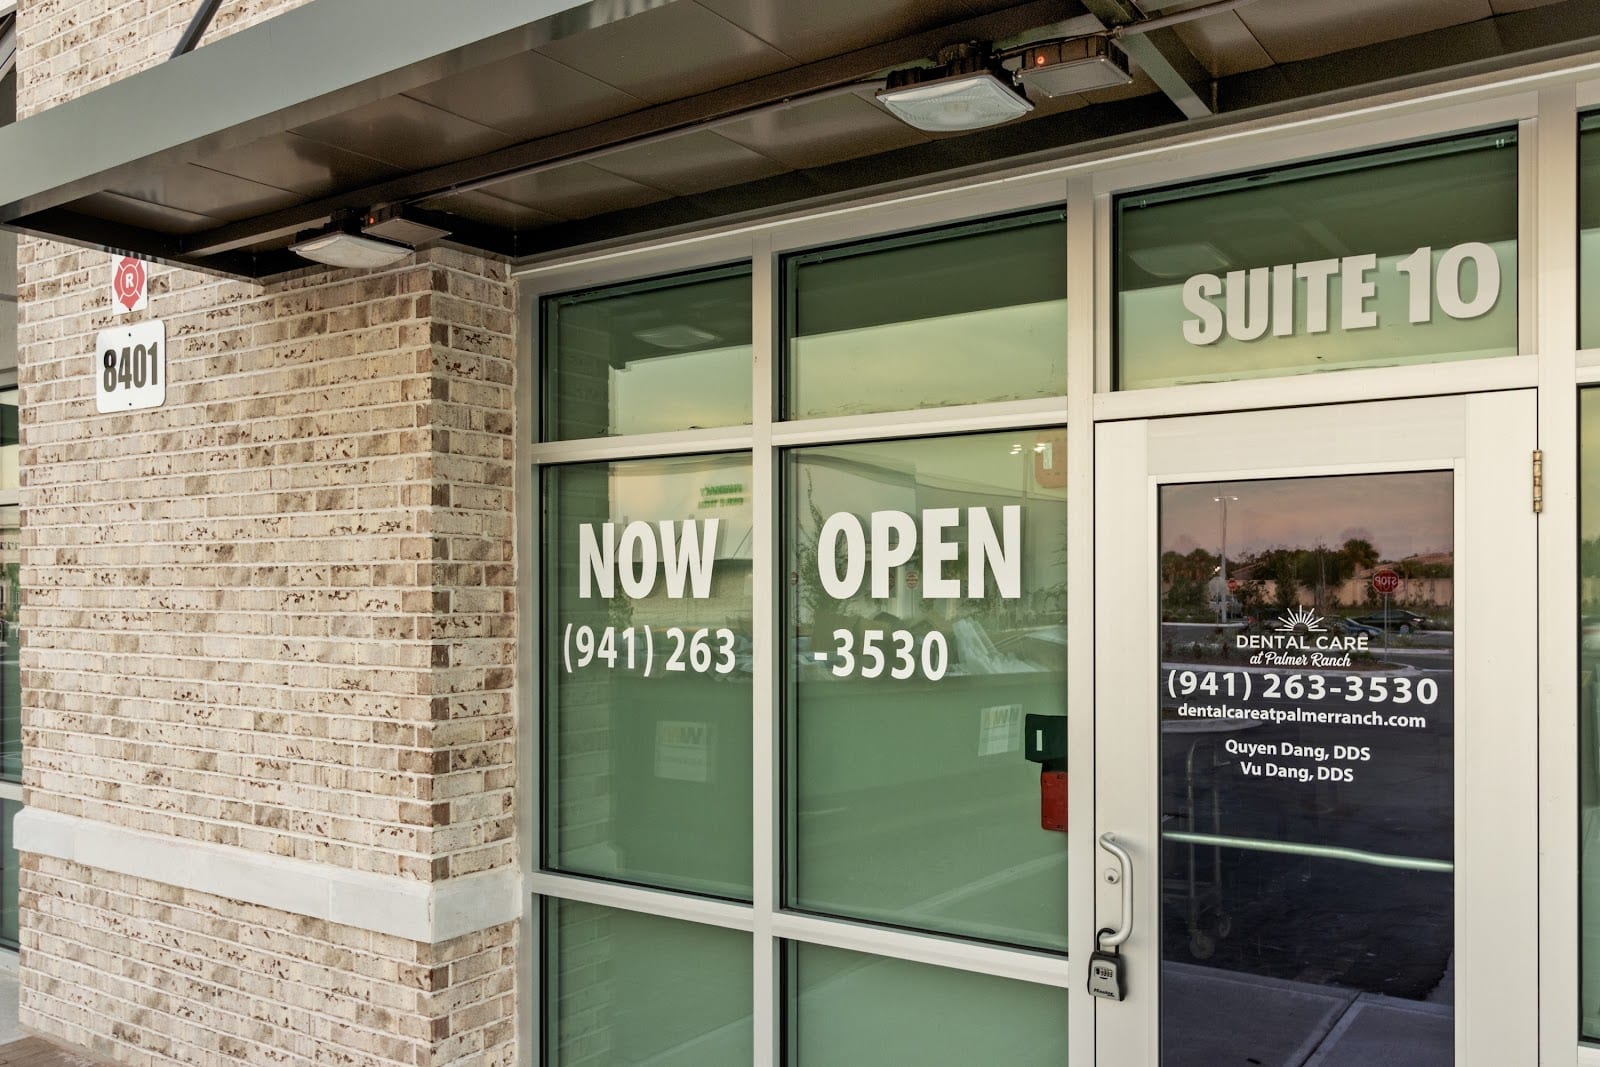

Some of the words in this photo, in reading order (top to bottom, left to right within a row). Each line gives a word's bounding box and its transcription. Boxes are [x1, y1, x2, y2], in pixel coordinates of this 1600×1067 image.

[125, 273, 134, 288] R
[1182, 253, 1378, 346] SUITE
[1396, 242, 1501, 324] 10
[103, 342, 158, 392] 8401
[578, 518, 720, 600] NOW
[817, 505, 1022, 600] OPEN
[563, 623, 655, 677] (941)
[665, 627, 737, 674] 263
[813, 628, 949, 682] -3530
[1236, 634, 1309, 650] DENTAL
[1316, 636, 1369, 651] CARE
[1249, 653, 1263, 666] at
[1265, 652, 1309, 667] Palmer
[1311, 653, 1351, 668] Ranch
[1167, 669, 1252, 701] (941)
[1263, 673, 1439, 705] 263-3530
[1177, 703, 1426, 728] dentalcareatpalmerranch.com
[1225, 739, 1278, 756] Quyen
[1281, 742, 1330, 762] Dang,
[1333, 745, 1371, 761] DDS
[1240, 761, 1262, 777] Vu
[1265, 763, 1314, 782] Dang,
[1317, 767, 1354, 783] DDS
